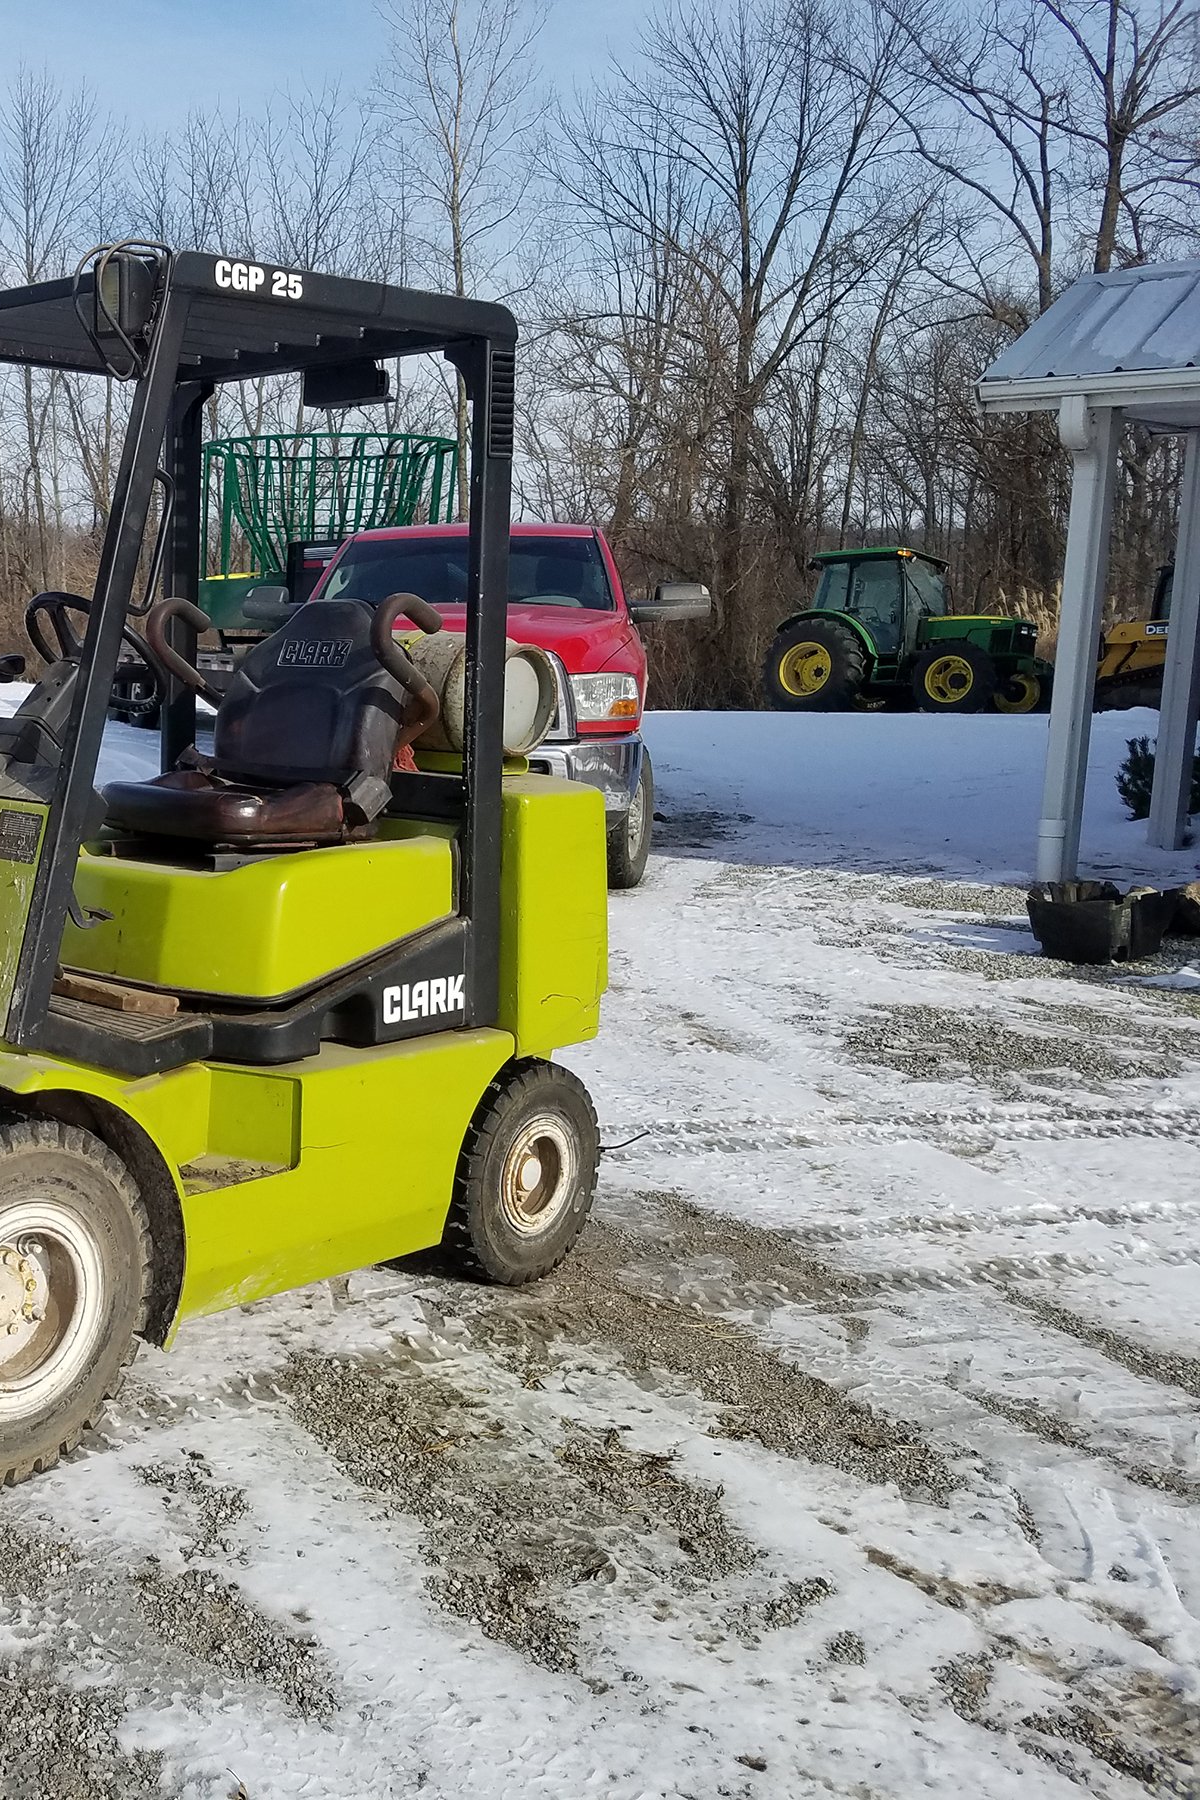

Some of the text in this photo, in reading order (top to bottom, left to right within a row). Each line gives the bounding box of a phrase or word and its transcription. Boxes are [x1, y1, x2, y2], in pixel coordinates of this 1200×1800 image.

[215, 260, 303, 299] CGP 25
[280, 640, 352, 666] CLARK
[383, 974, 465, 1024] CLARK
